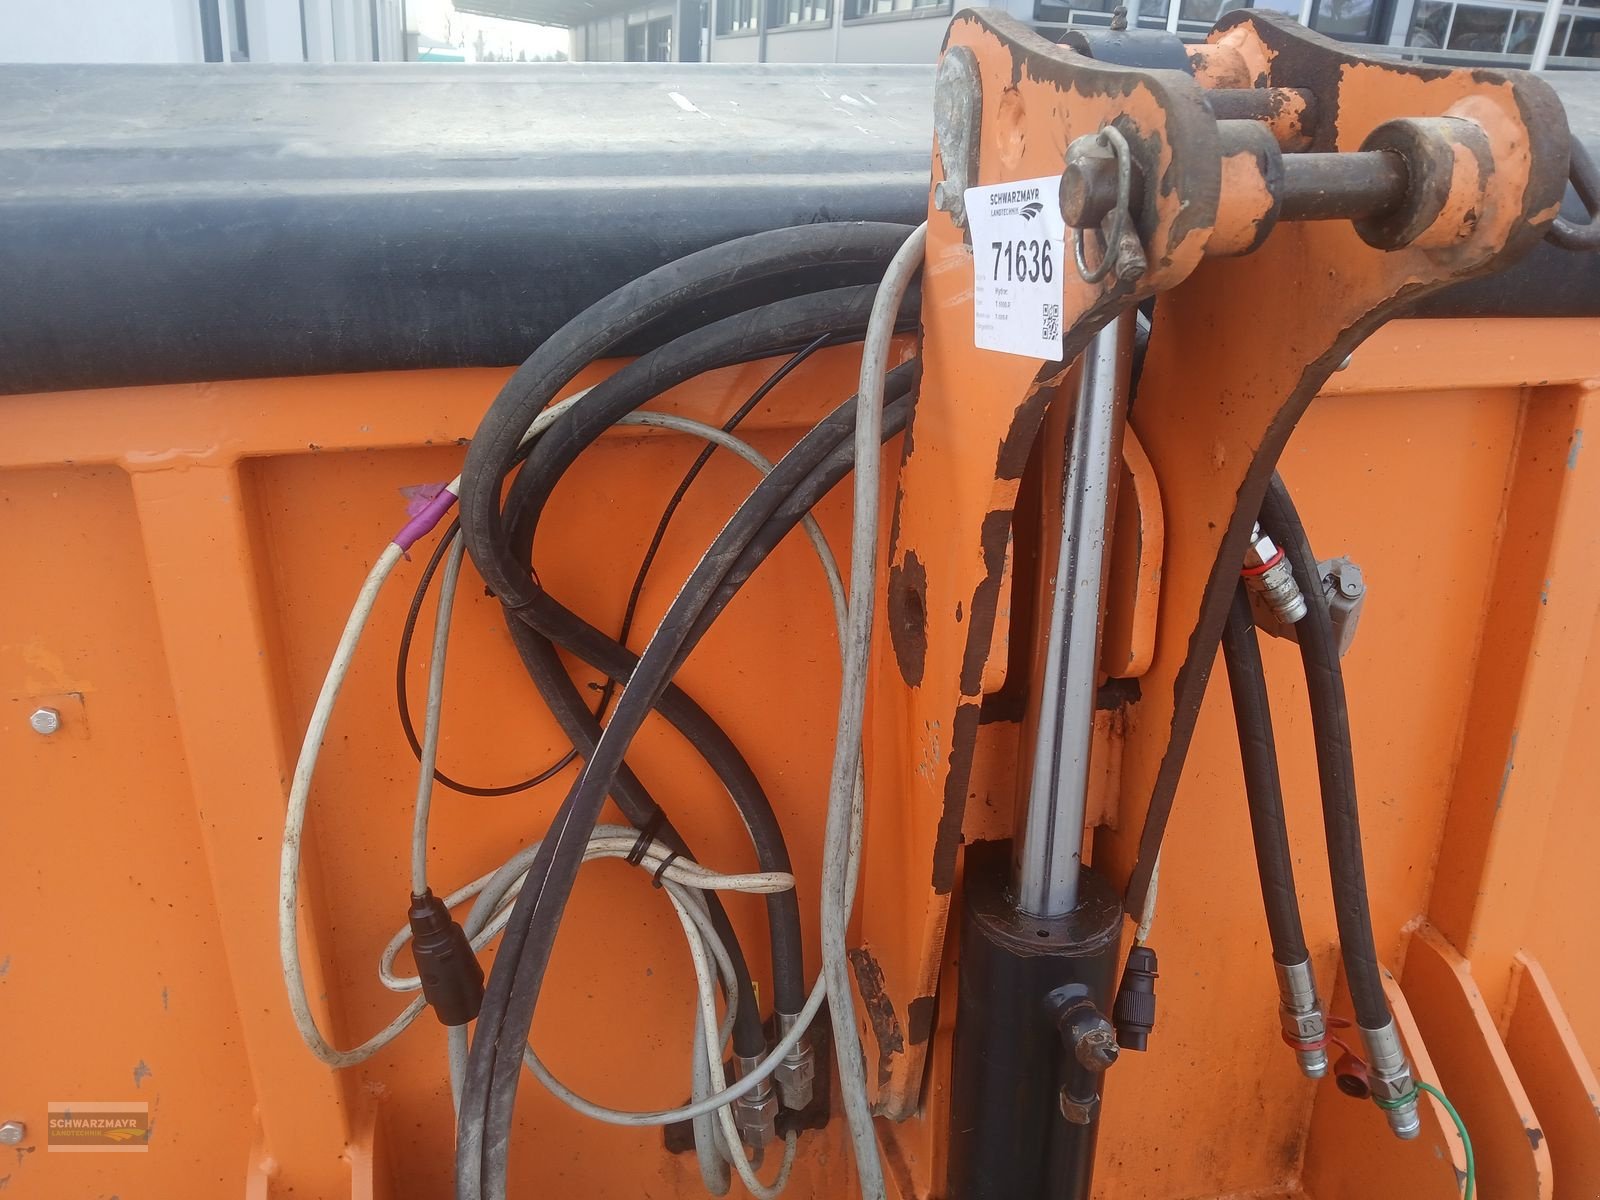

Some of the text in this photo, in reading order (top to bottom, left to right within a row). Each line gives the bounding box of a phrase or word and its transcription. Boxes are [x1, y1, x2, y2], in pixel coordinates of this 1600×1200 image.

[990, 188, 1039, 205] SCHWARZMAYR
[991, 207, 1020, 217] LANDTECHNIK
[991, 239, 1053, 283] 71636
[1303, 1020, 1317, 1033] R
[1390, 1076, 1409, 1095] V
